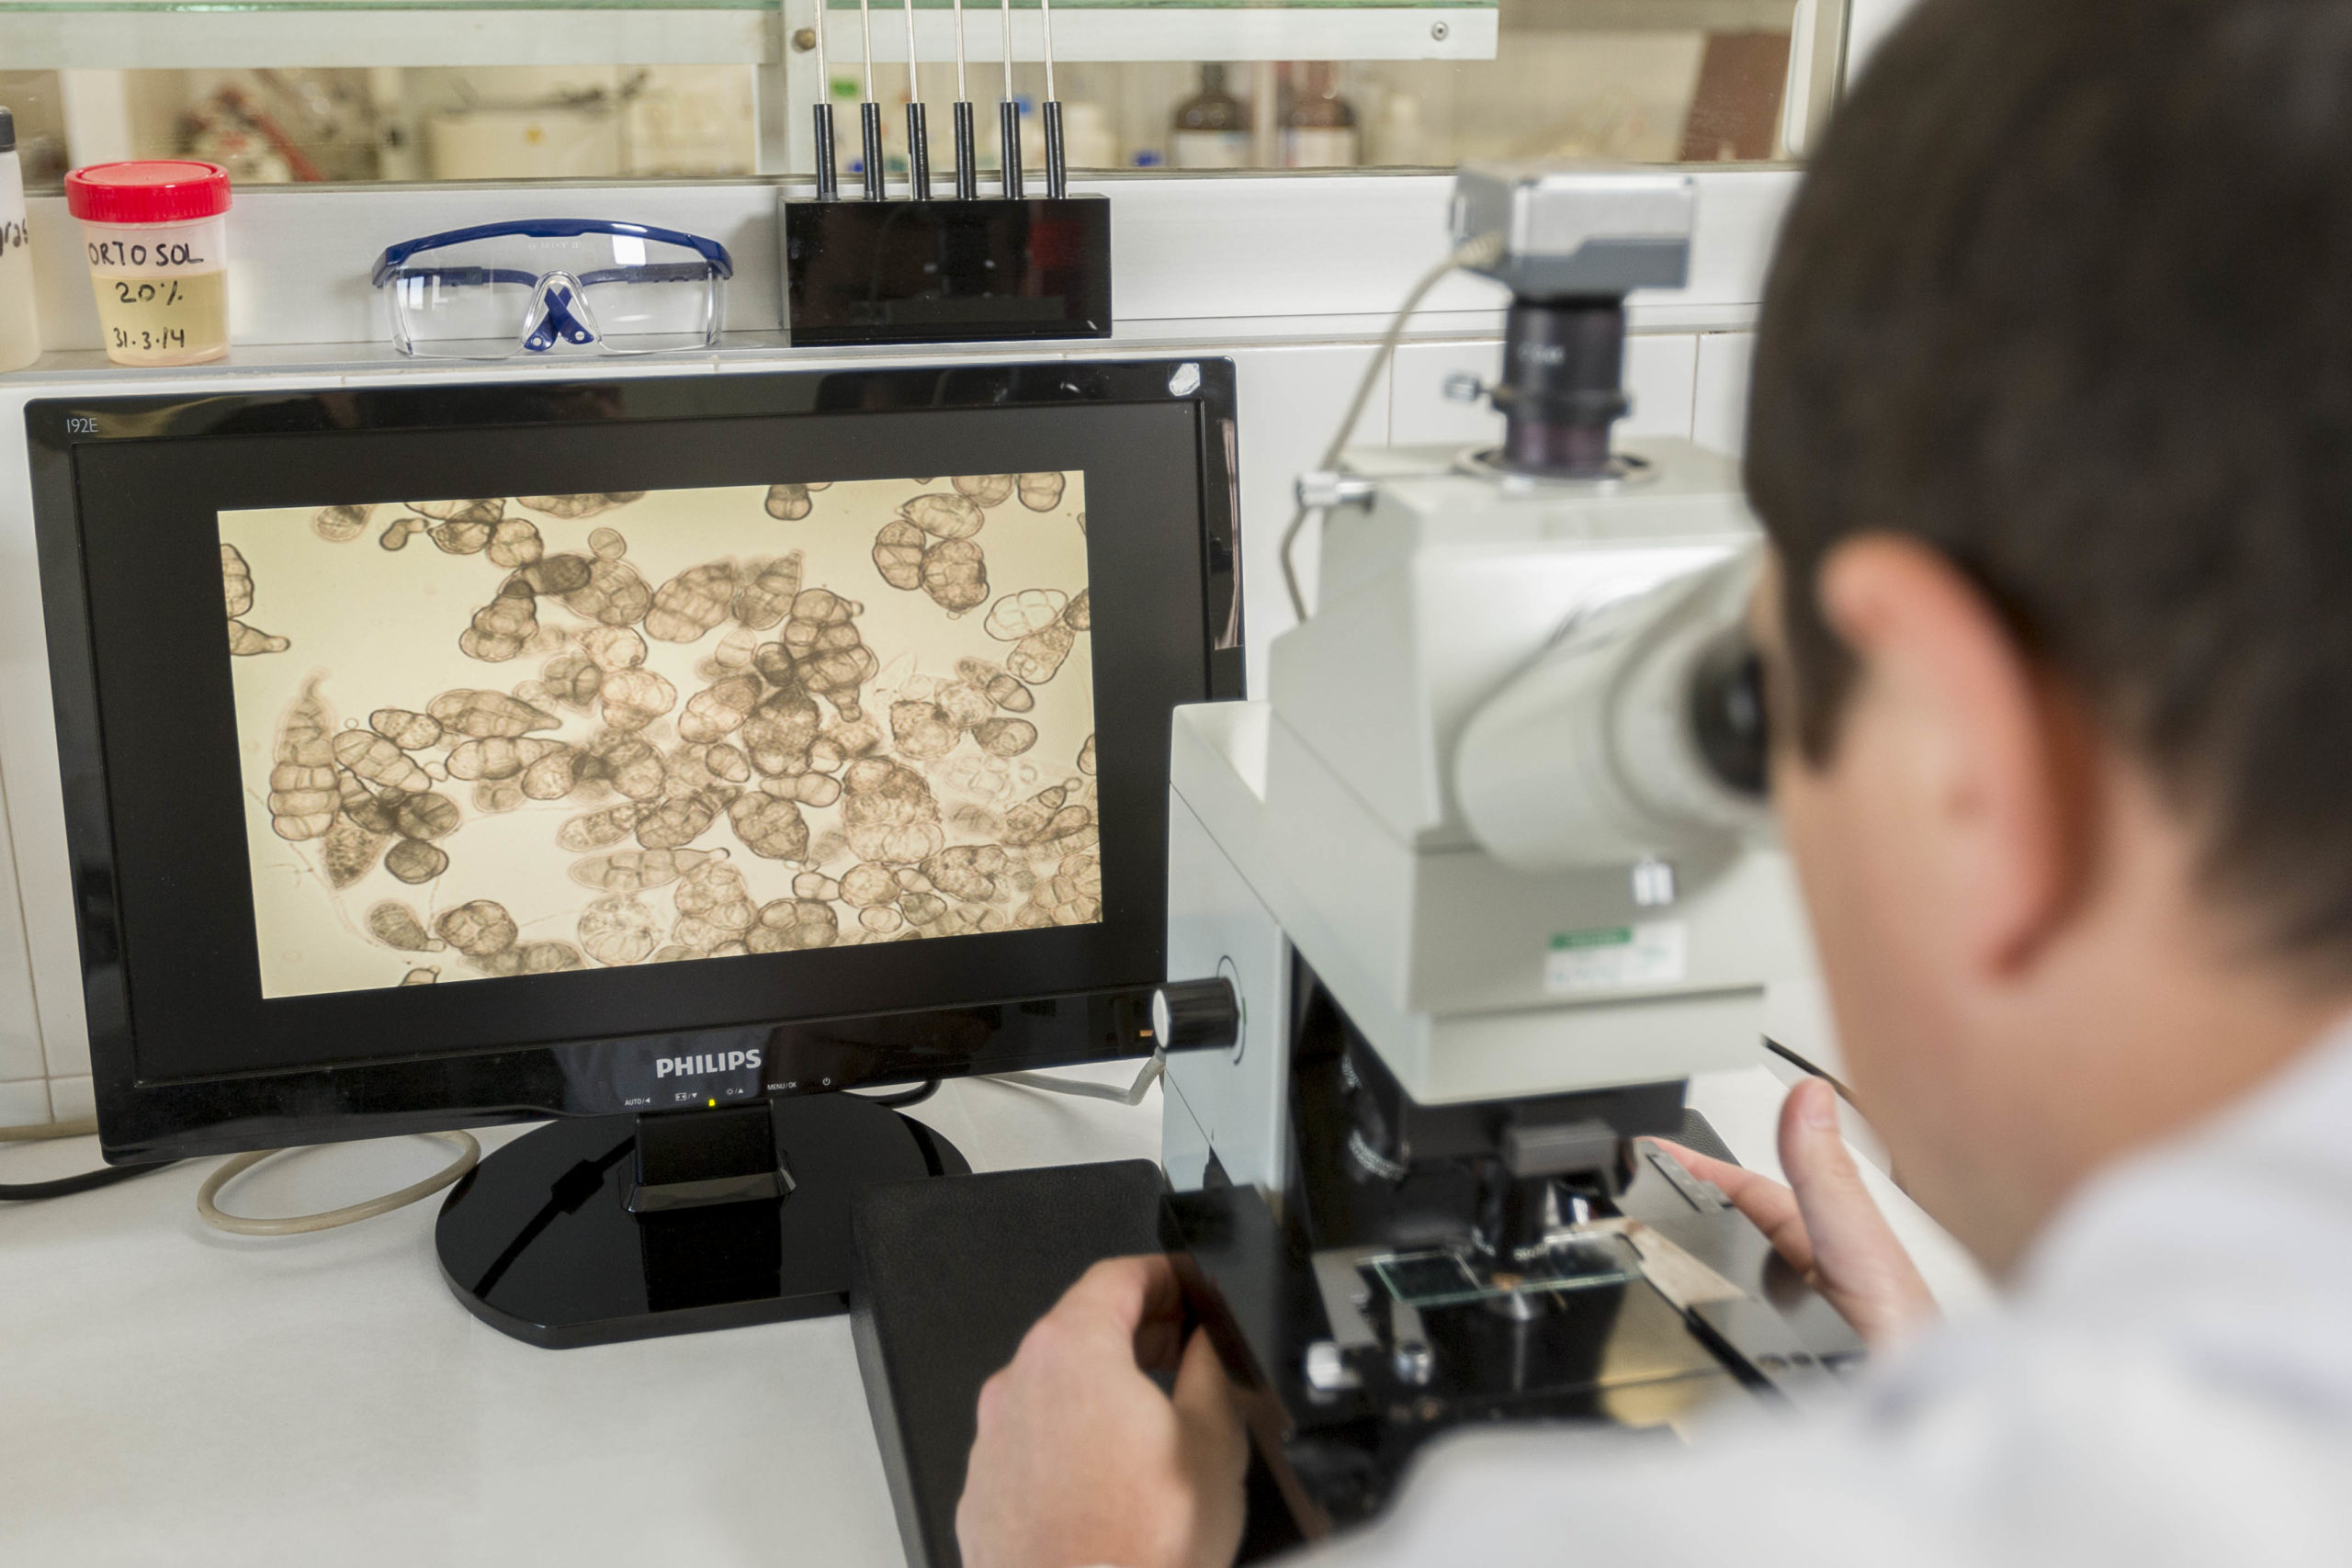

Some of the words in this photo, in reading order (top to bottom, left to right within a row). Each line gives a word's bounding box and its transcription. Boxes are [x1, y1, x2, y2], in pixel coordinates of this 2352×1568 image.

[115, 280, 183, 305] 20%
[66, 417, 98, 434] 192E
[656, 1048, 762, 1078] PHILIPS
